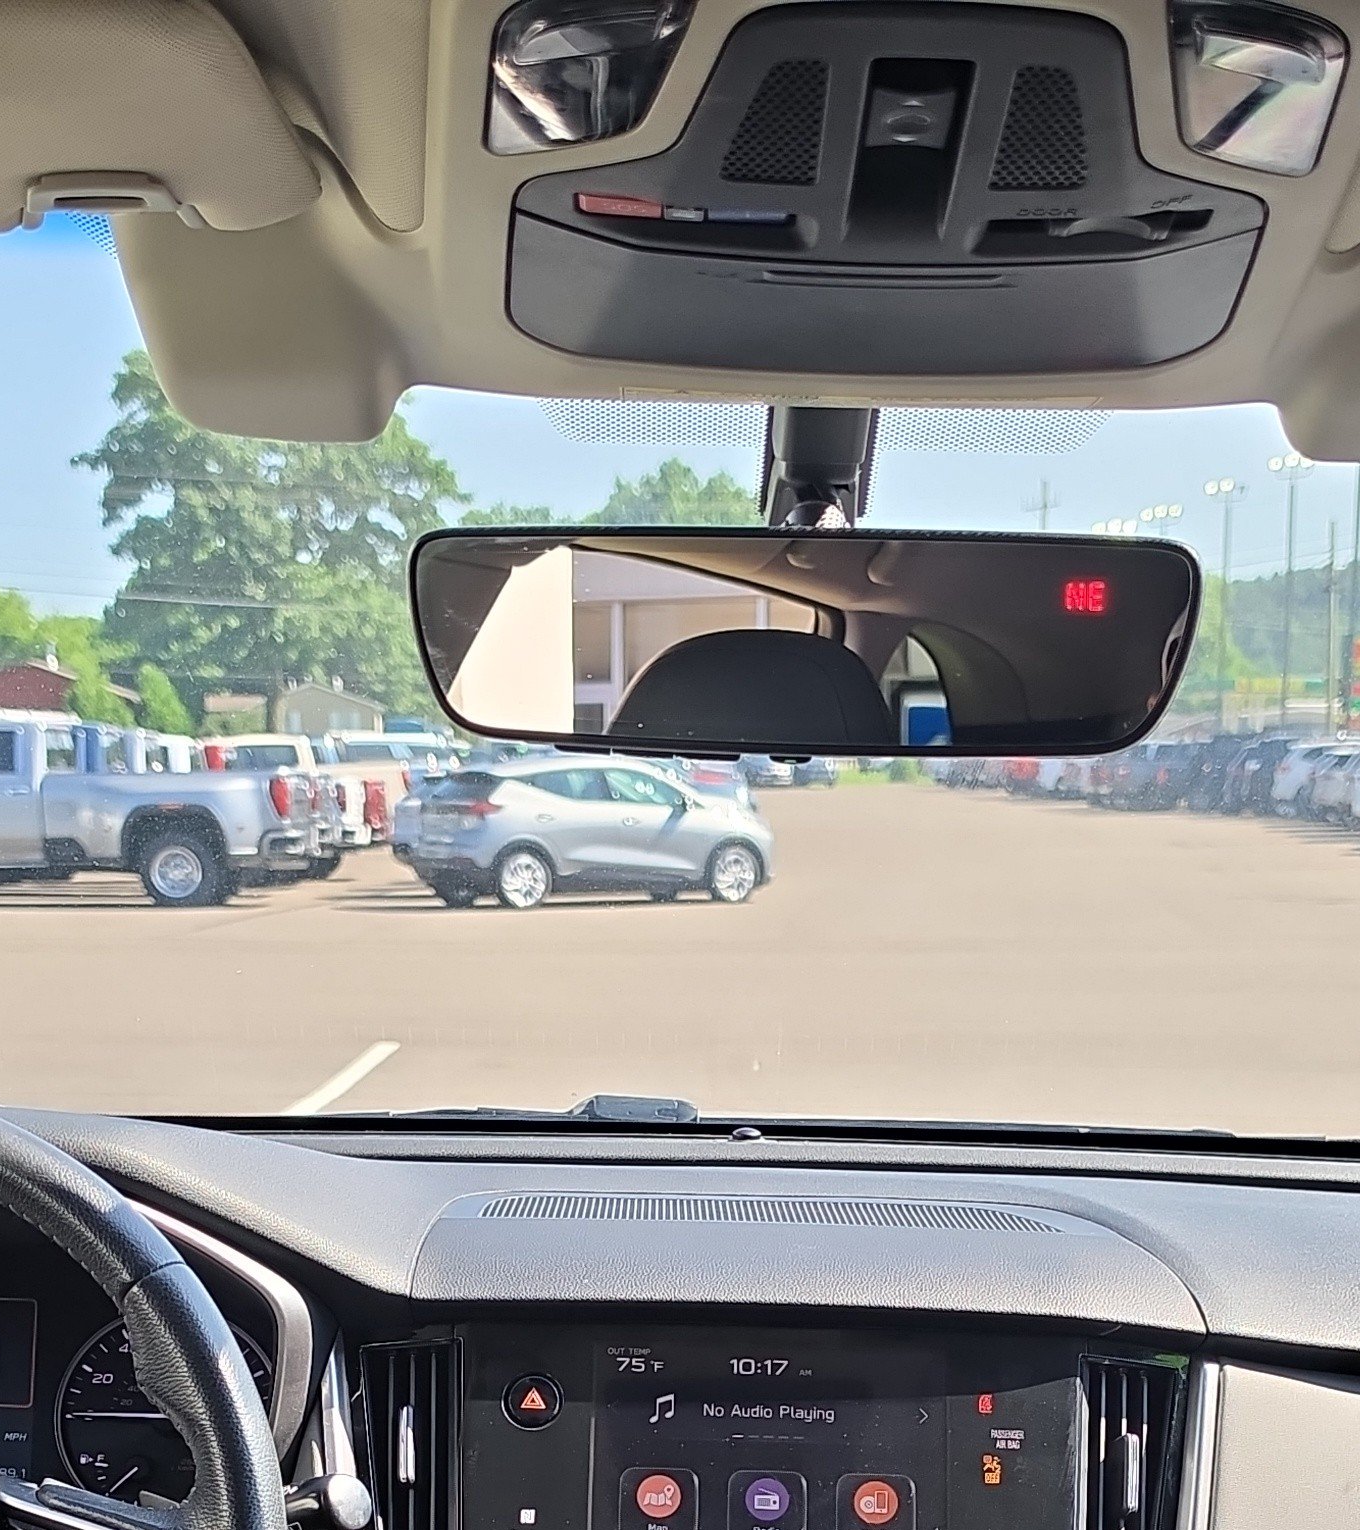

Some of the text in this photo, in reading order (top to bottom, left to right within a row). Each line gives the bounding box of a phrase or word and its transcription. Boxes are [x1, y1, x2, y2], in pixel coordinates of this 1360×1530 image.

[1016, 207, 1078, 217] DOOR
[1065, 581, 1105, 611] NE
[607, 1347, 651, 1356] OUT TEMP
[616, 1357, 646, 1372] 75
[729, 1358, 813, 1377] 10:17 AM
[92, 1373, 114, 1384] 20
[702, 1403, 835, 1424] No Audio Playing
[4, 1432, 28, 1442] MPH
[990, 1429, 1025, 1439] PASSENGER
[996, 1440, 1021, 1449] AIR BAG
[97, 1454, 105, 1462] F
